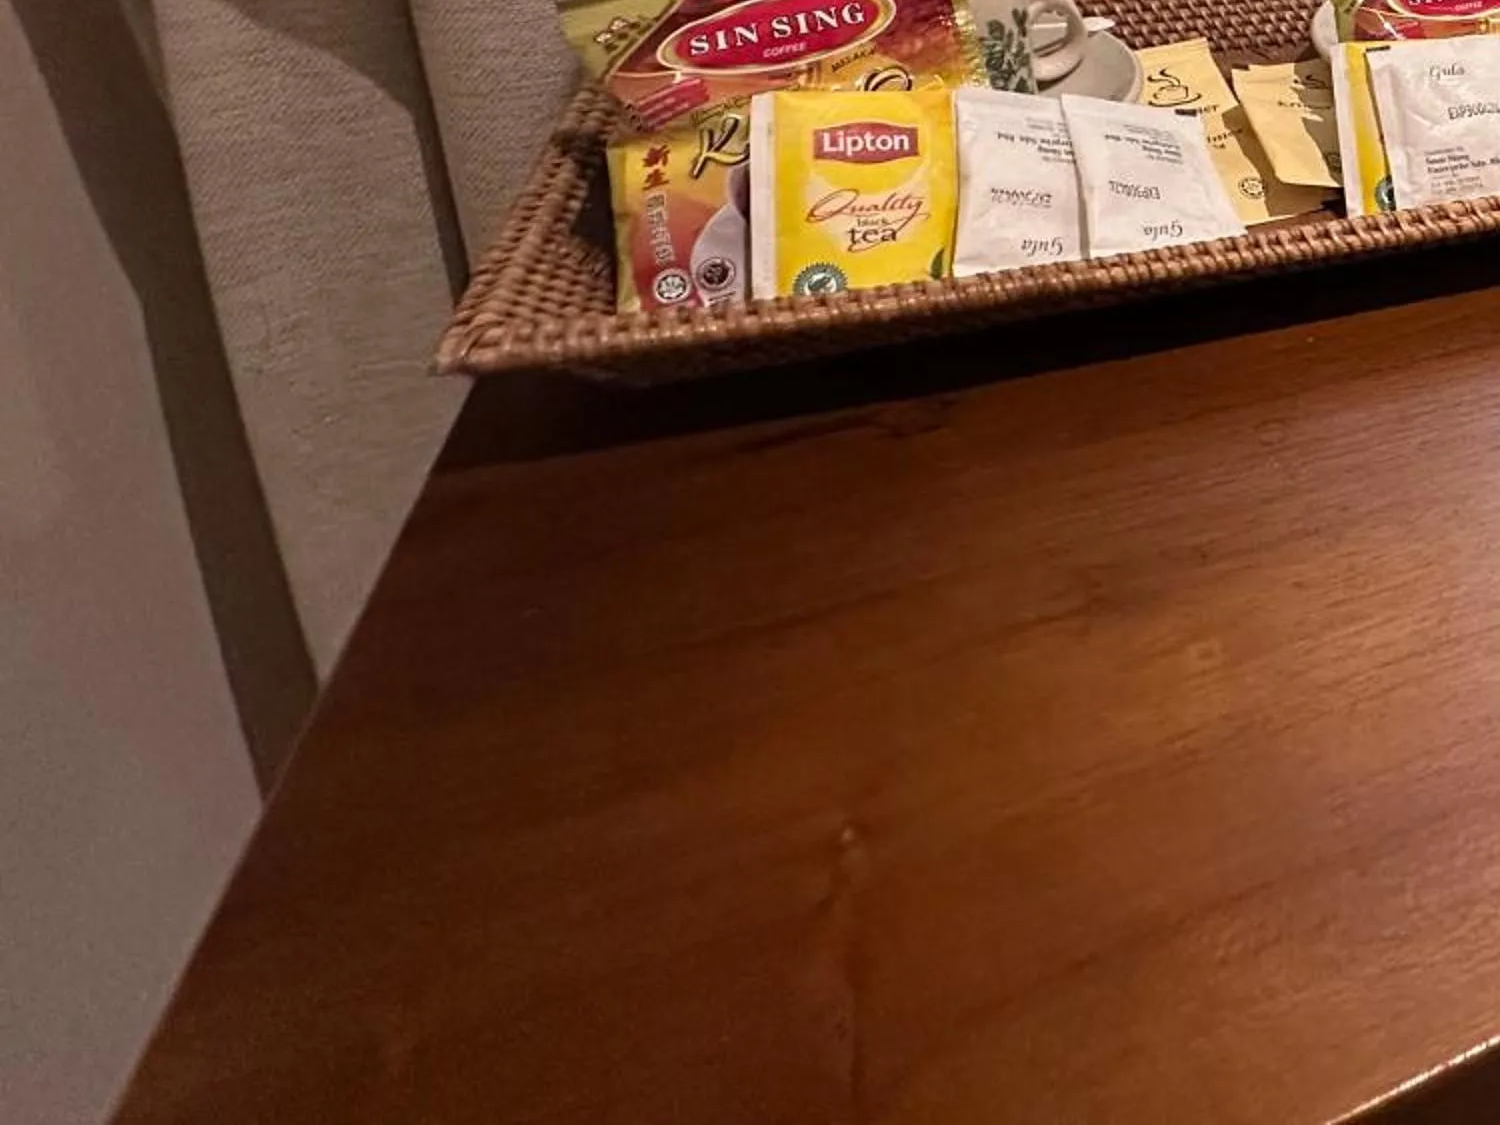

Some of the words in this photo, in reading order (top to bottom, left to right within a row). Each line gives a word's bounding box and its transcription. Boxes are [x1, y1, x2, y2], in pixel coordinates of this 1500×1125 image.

[689, 22, 760, 56] SIN
[771, 2, 866, 39] SING
[762, 41, 808, 59] COFFEE
[822, 130, 911, 156] Lipton
[804, 187, 932, 224] Quality
[847, 226, 898, 246] tea
[1142, 219, 1184, 243] Gula
[1020, 236, 1065, 257] Gula
